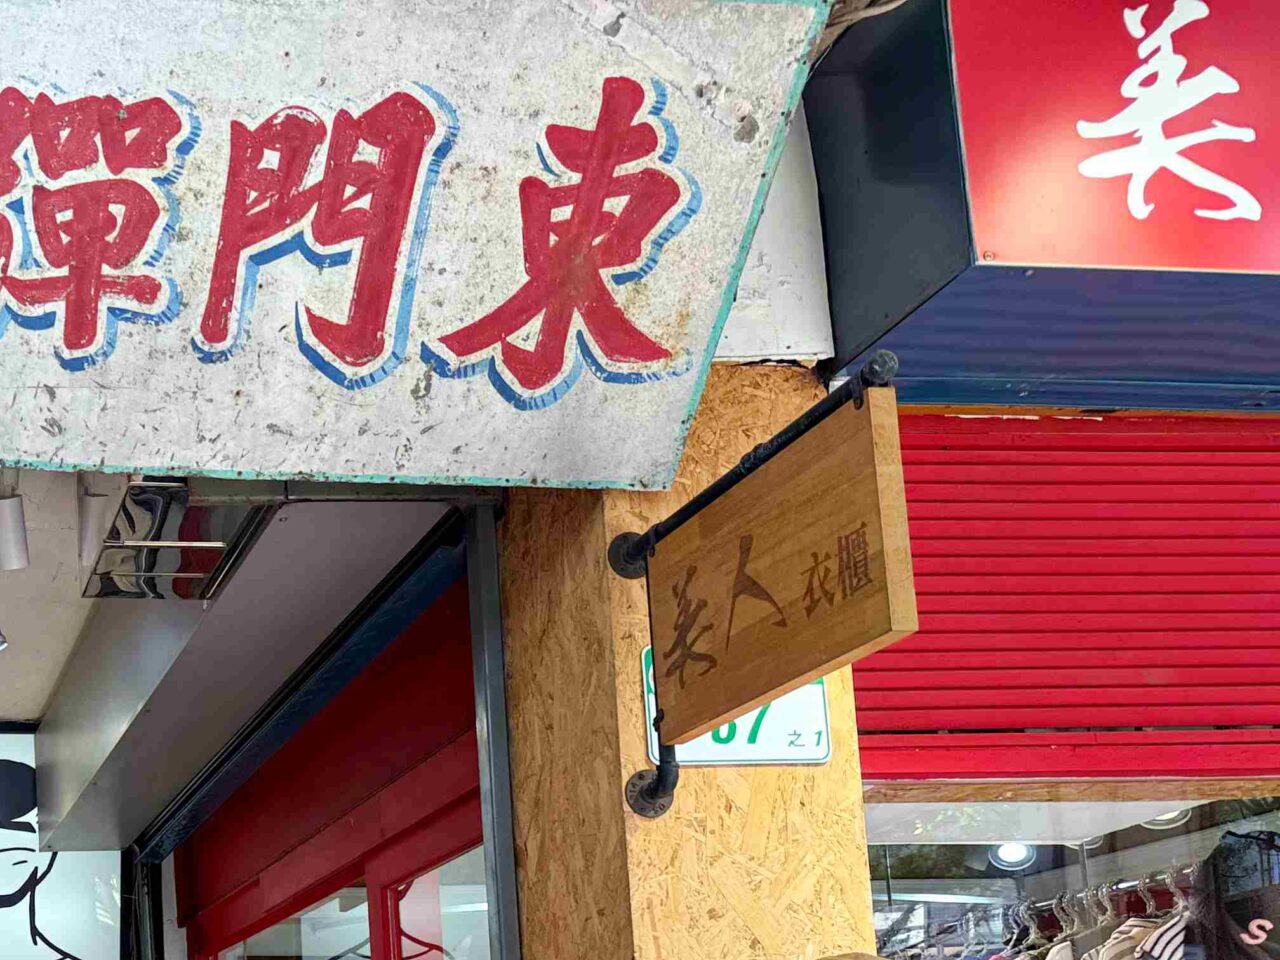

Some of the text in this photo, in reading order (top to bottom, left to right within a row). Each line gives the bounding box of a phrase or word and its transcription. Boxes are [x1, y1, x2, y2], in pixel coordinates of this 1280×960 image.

[1076, 0, 1263, 222] 美
[662, 520, 875, 690] 美人衣櫃
